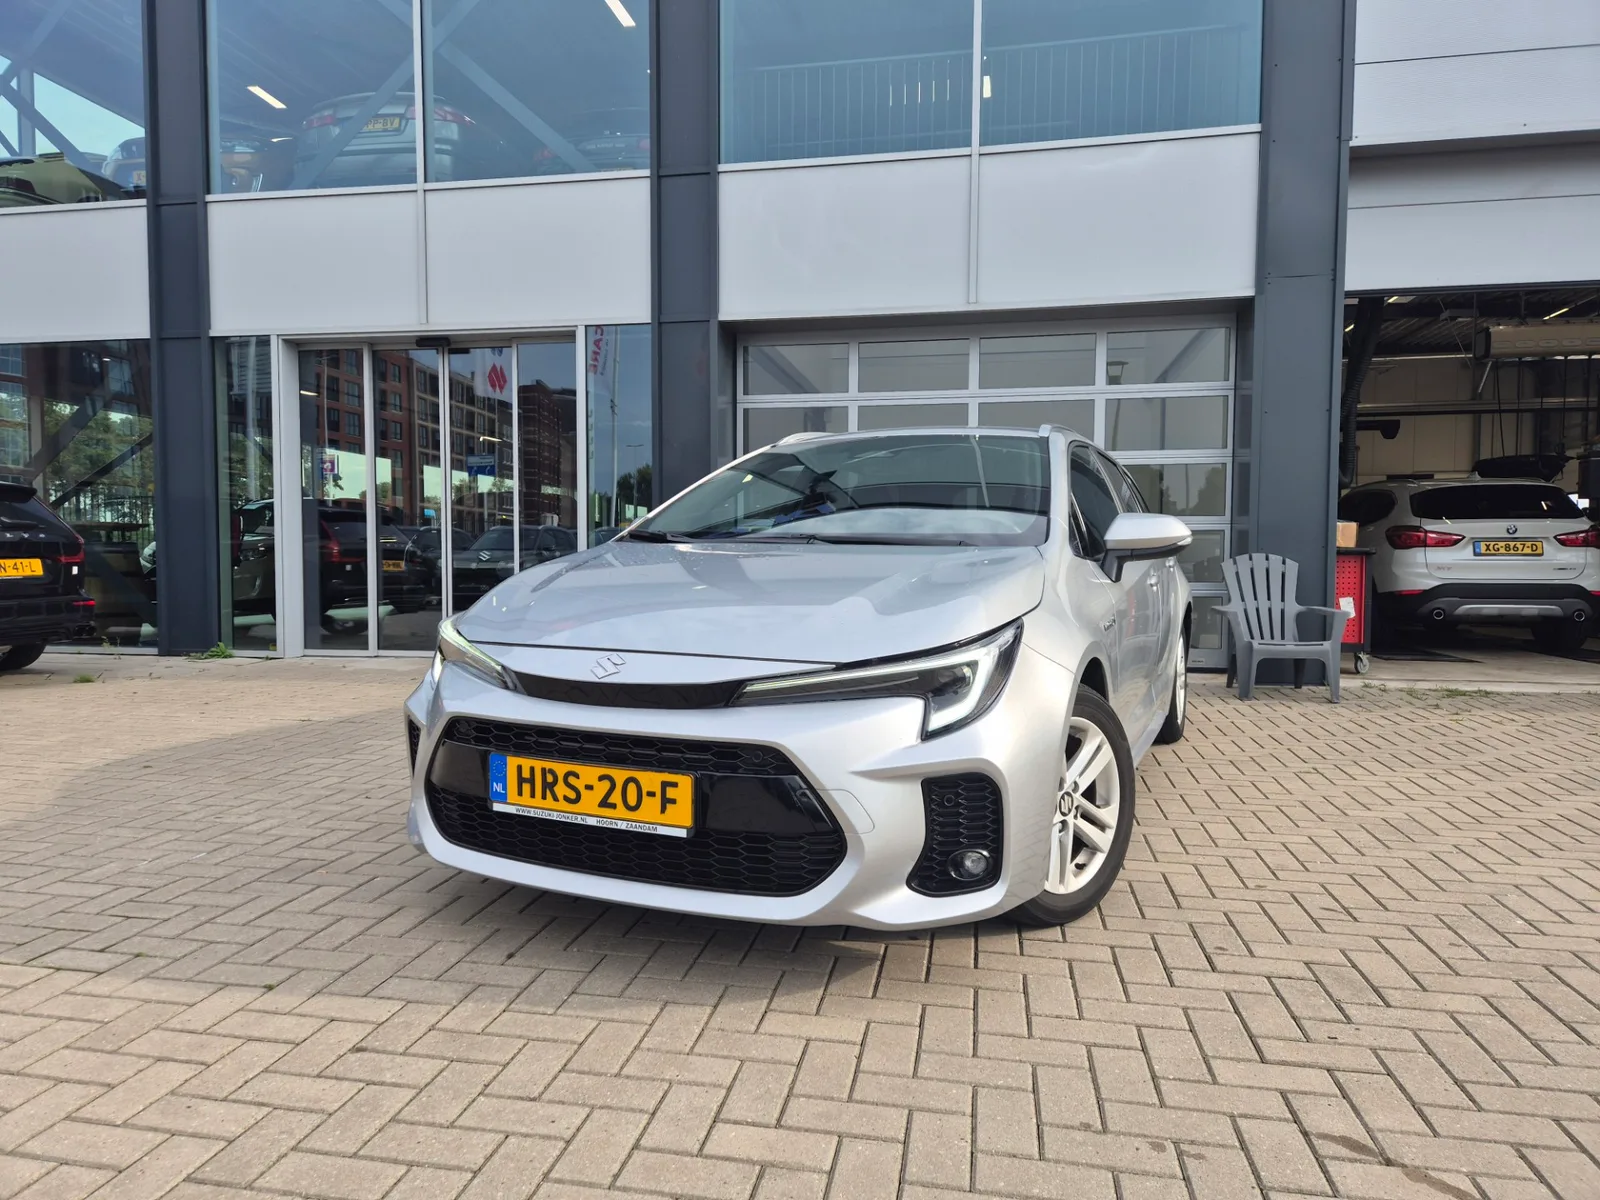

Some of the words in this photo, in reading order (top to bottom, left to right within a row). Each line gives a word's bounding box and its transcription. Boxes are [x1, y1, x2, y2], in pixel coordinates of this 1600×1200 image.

[1484, 543, 1539, 553] XG-867-D
[493, 781, 506, 794] NL
[516, 764, 679, 815] HRS-20-F
[595, 818, 619, 828] HOORN
[625, 822, 658, 832] ZAANDAM
